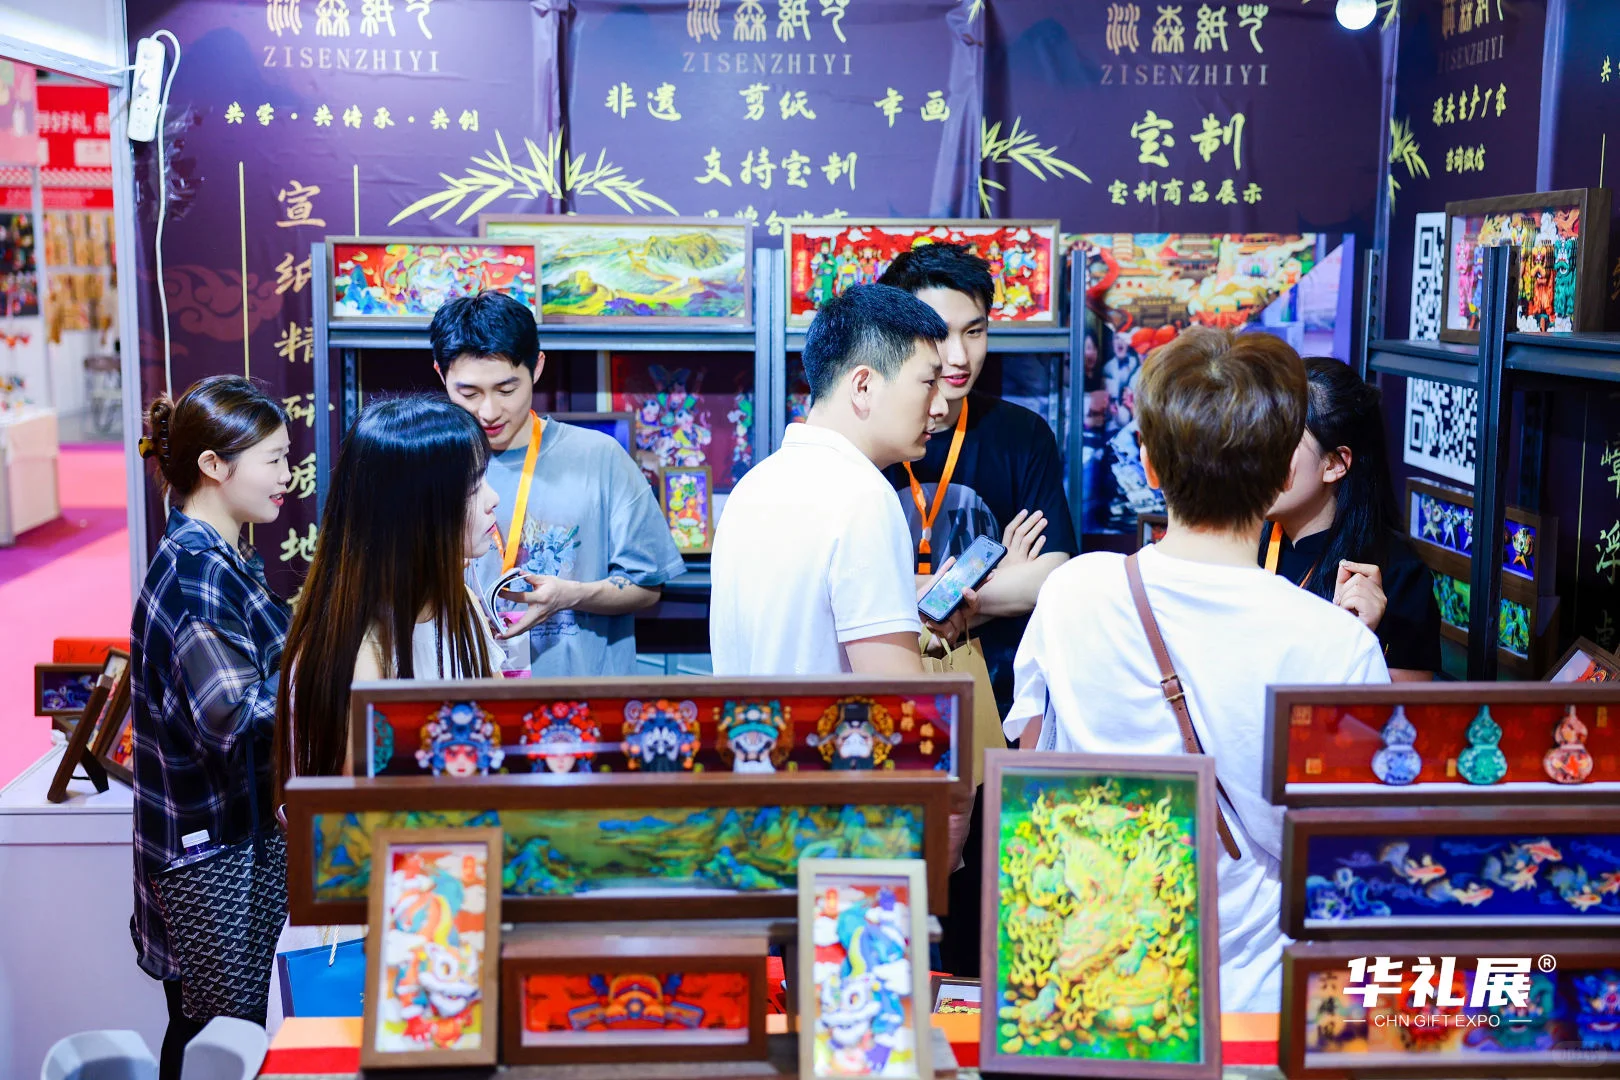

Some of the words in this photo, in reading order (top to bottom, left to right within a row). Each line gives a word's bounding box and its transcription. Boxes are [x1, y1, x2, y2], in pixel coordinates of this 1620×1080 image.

[263, 45, 440, 72] ZISENZHIYI
[682, 52, 853, 75] ZISENZHIYI
[1101, 63, 1269, 86] ZISENZHIYI
[604, 81, 682, 122] 非遗
[739, 82, 817, 121] 剪纸
